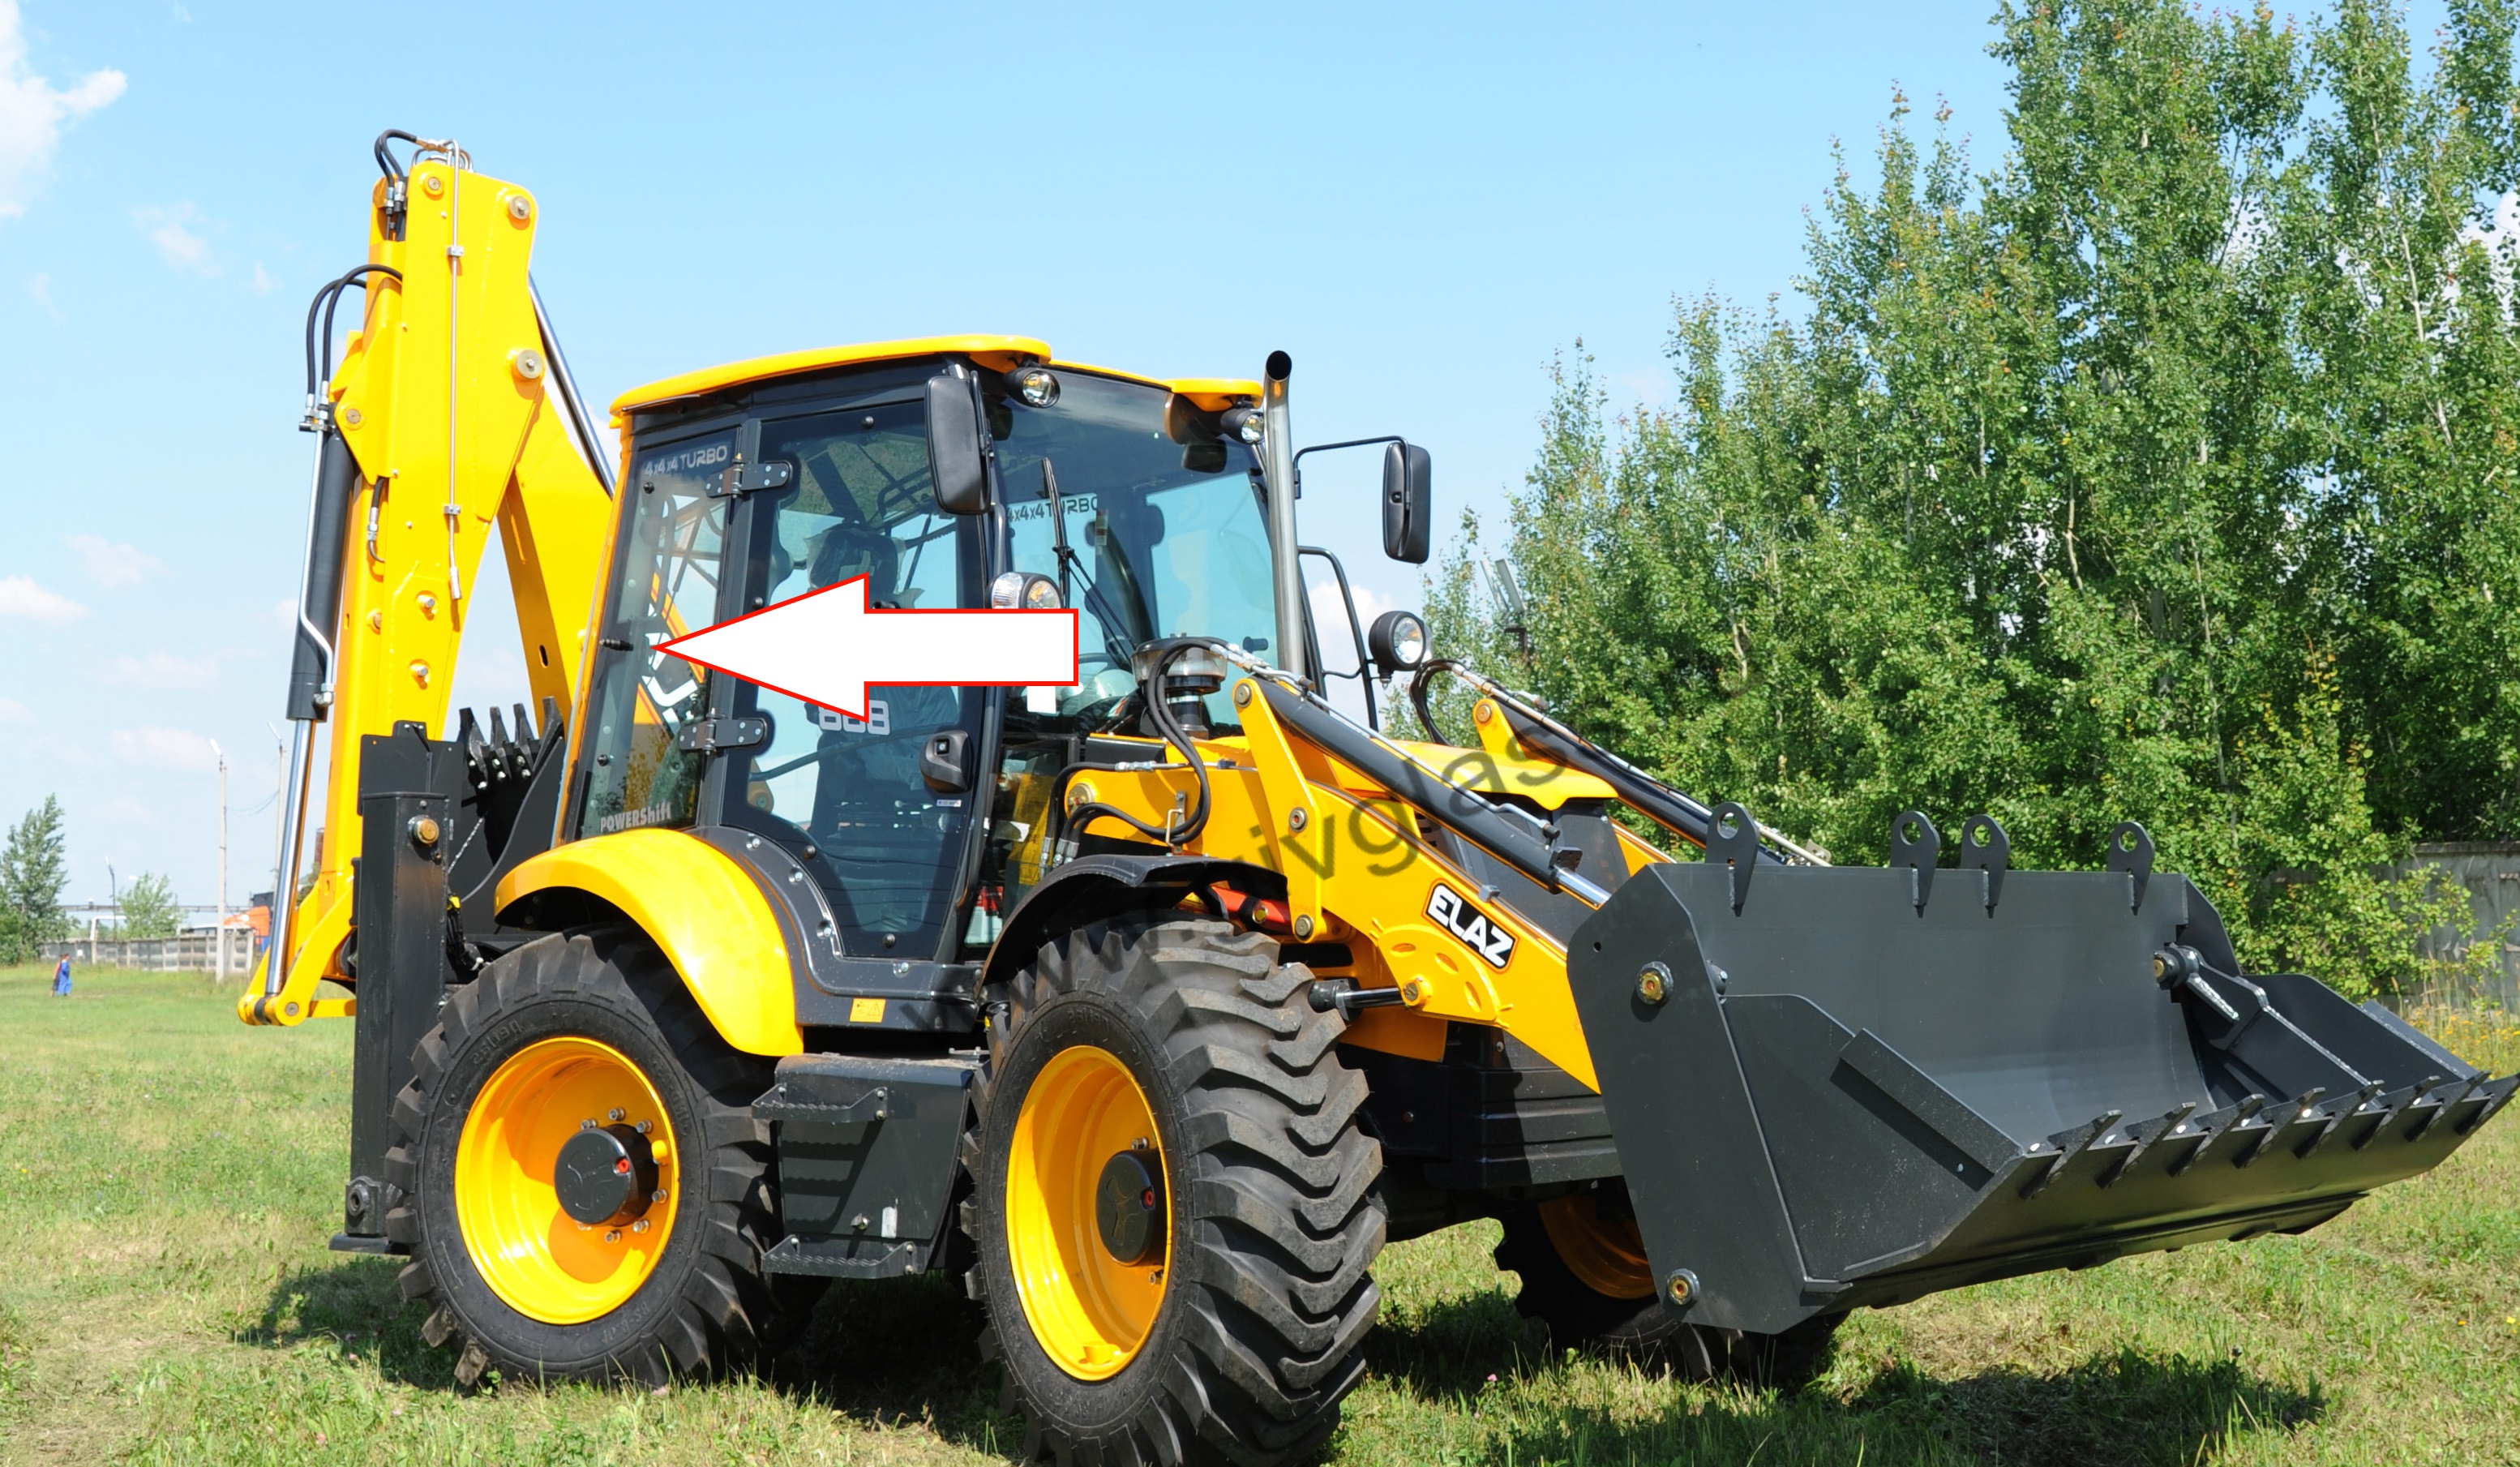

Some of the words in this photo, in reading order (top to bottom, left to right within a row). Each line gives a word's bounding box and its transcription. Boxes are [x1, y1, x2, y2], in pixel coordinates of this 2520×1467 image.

[645, 455, 679, 477] 4x4x4
[679, 444, 728, 470] TURBO
[1427, 884, 1515, 967] ELAZ
